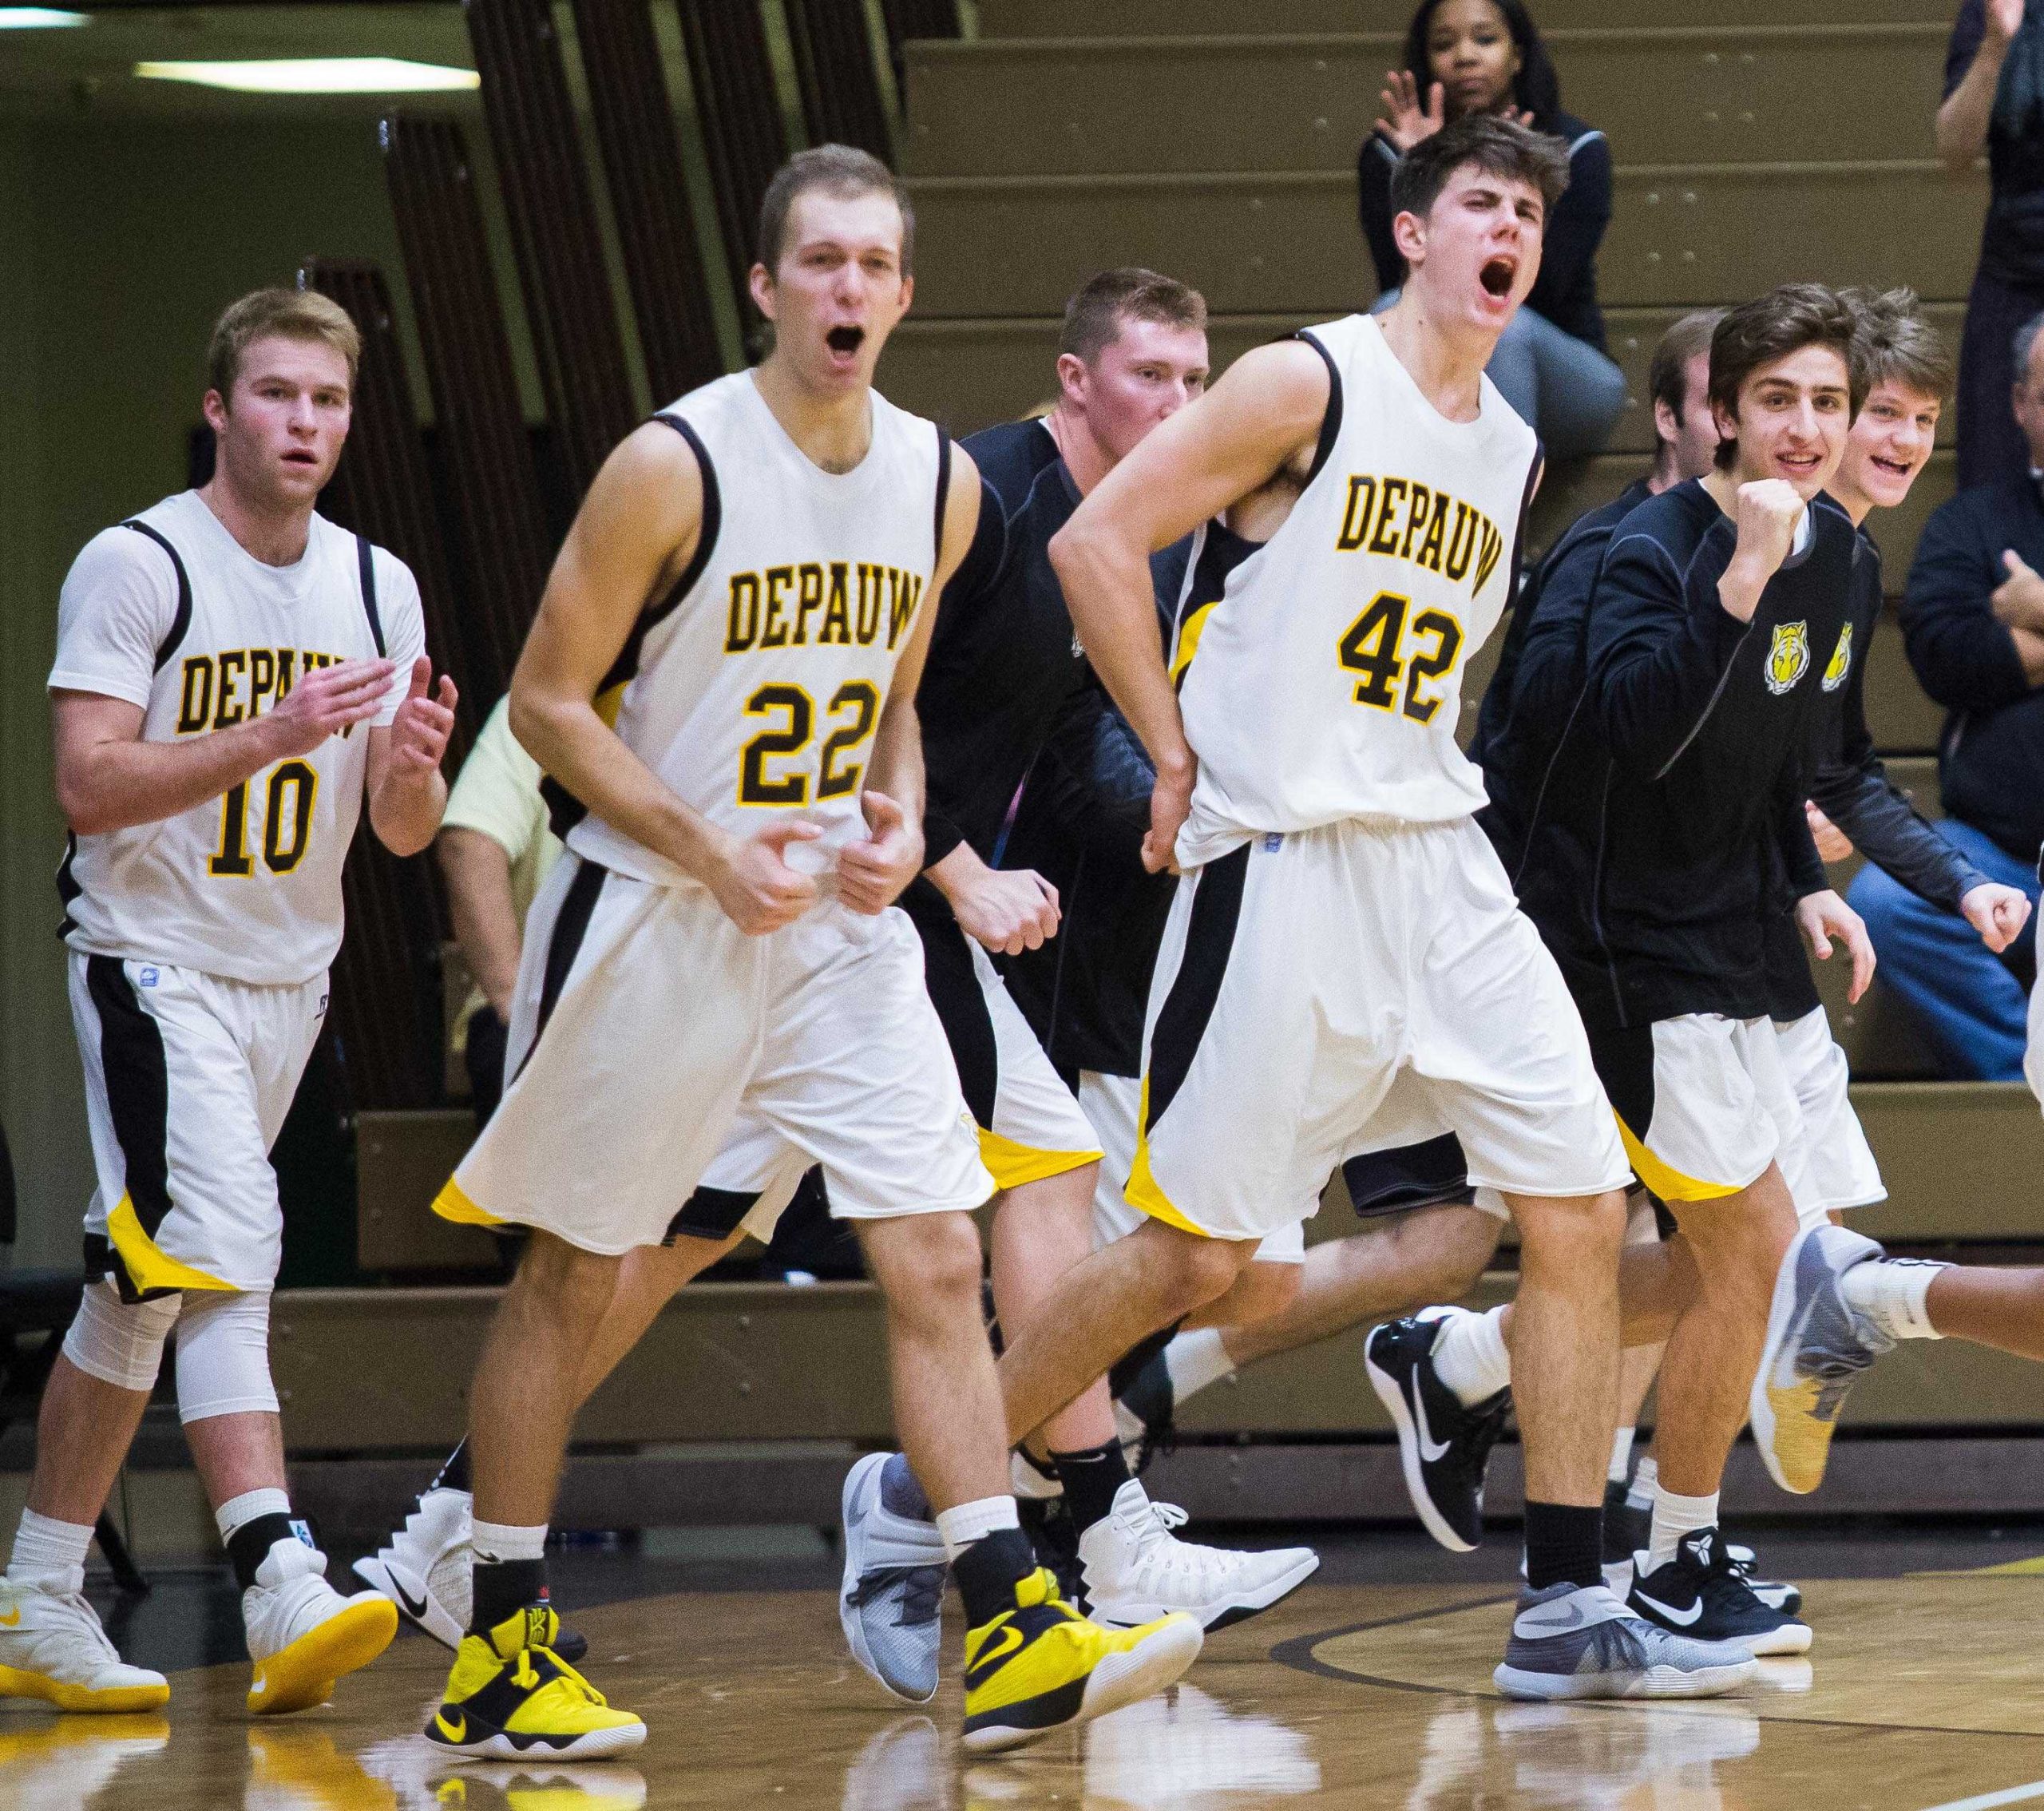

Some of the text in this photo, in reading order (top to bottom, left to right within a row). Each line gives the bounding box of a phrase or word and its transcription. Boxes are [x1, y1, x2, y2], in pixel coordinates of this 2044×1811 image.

[1336, 473, 1503, 600] DEPAUW
[723, 561, 924, 655] DEPAUW
[1337, 589, 1466, 726] 42
[175, 647, 354, 739] DEPA
[736, 679, 881, 808] 22
[208, 759, 319, 878] 10
